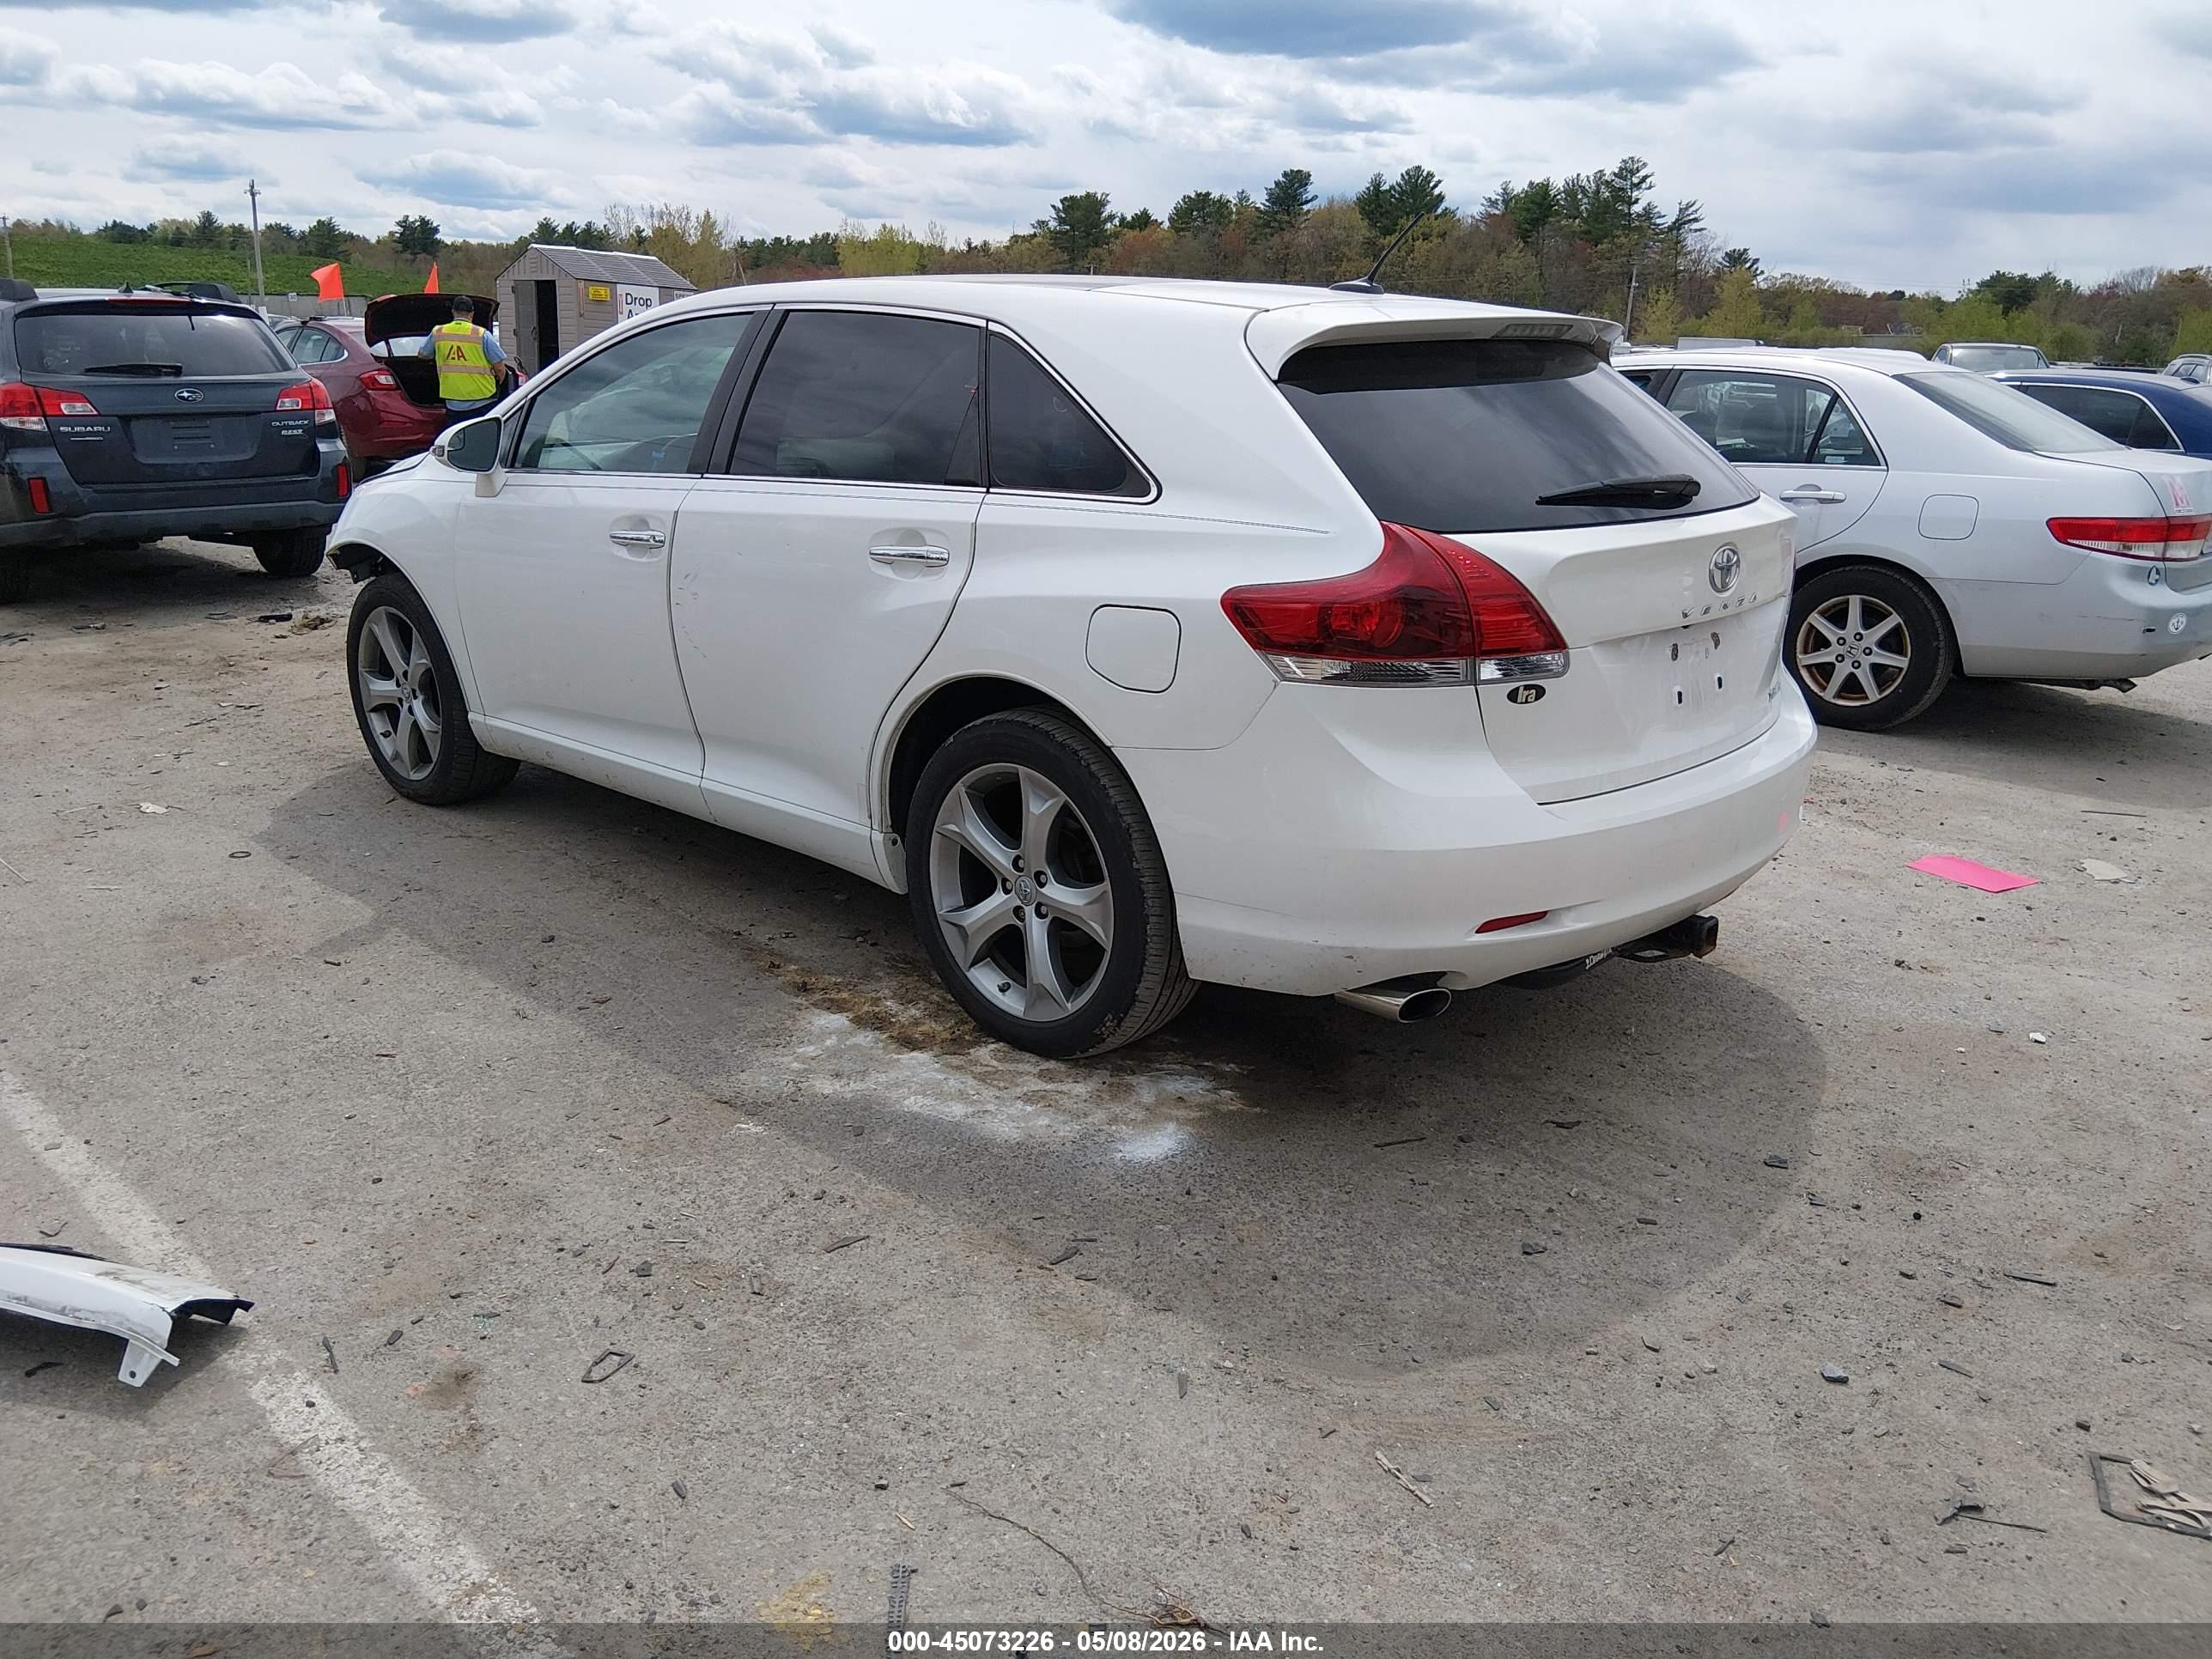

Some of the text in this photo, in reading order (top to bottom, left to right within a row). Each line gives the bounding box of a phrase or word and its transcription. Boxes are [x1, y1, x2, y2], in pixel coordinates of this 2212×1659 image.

[624, 293, 653, 310] Drop
[1680, 590, 1758, 619] VENZA
[1516, 685, 1536, 703] Ira
